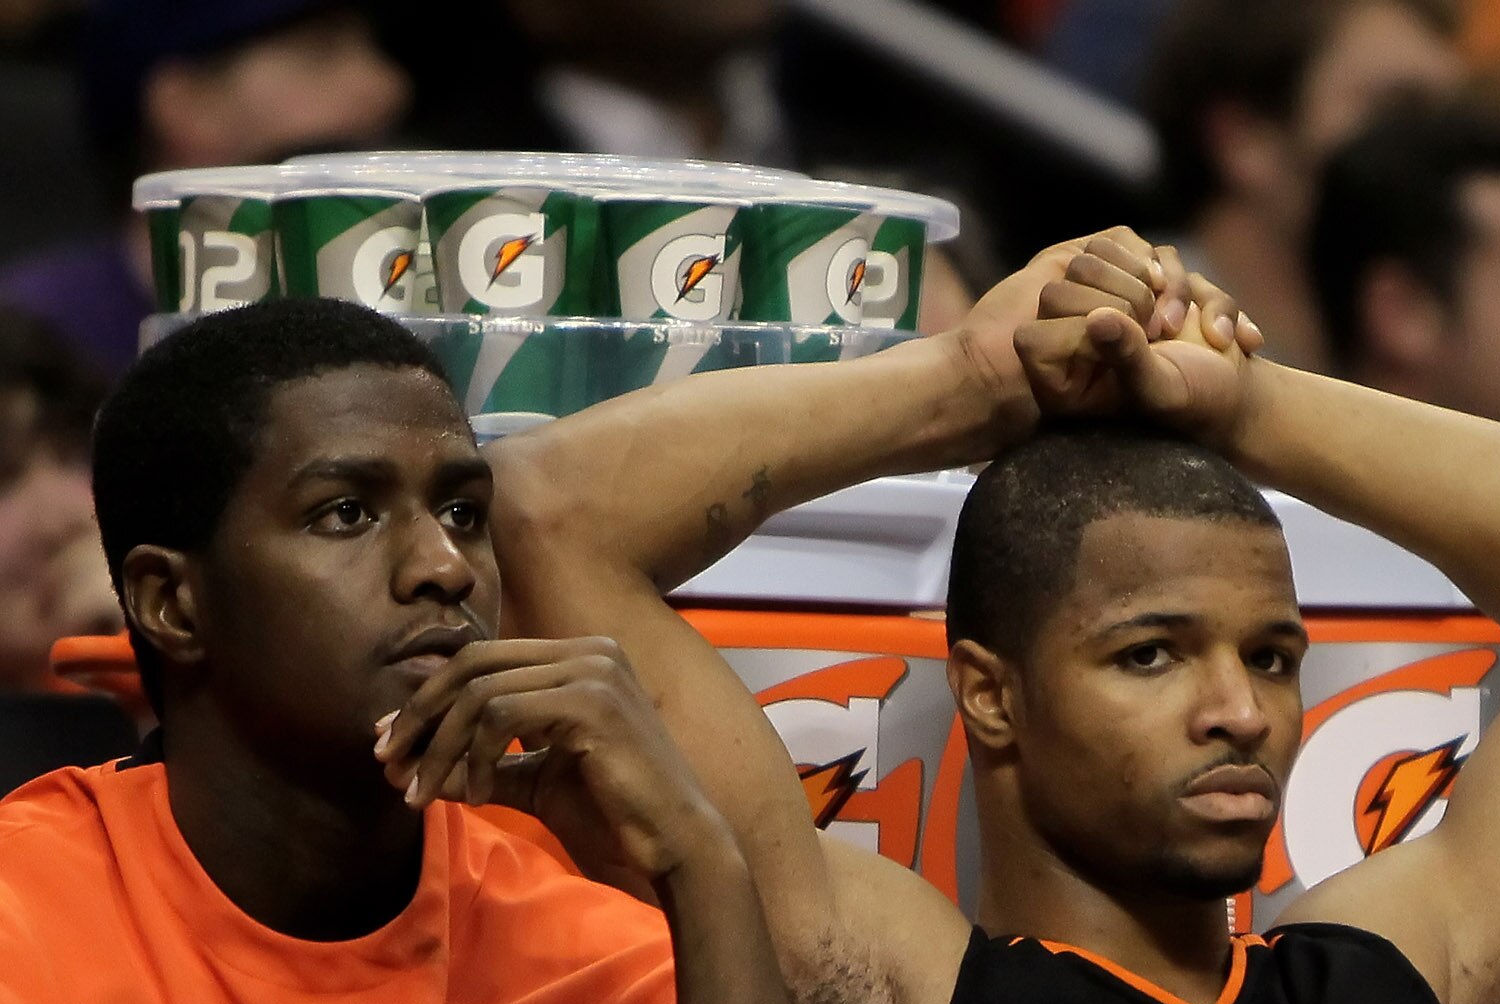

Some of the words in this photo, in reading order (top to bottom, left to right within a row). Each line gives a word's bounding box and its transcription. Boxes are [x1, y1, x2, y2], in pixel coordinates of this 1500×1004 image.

[458, 212, 545, 309] G
[651, 233, 726, 321] G
[1283, 687, 1481, 890] G
